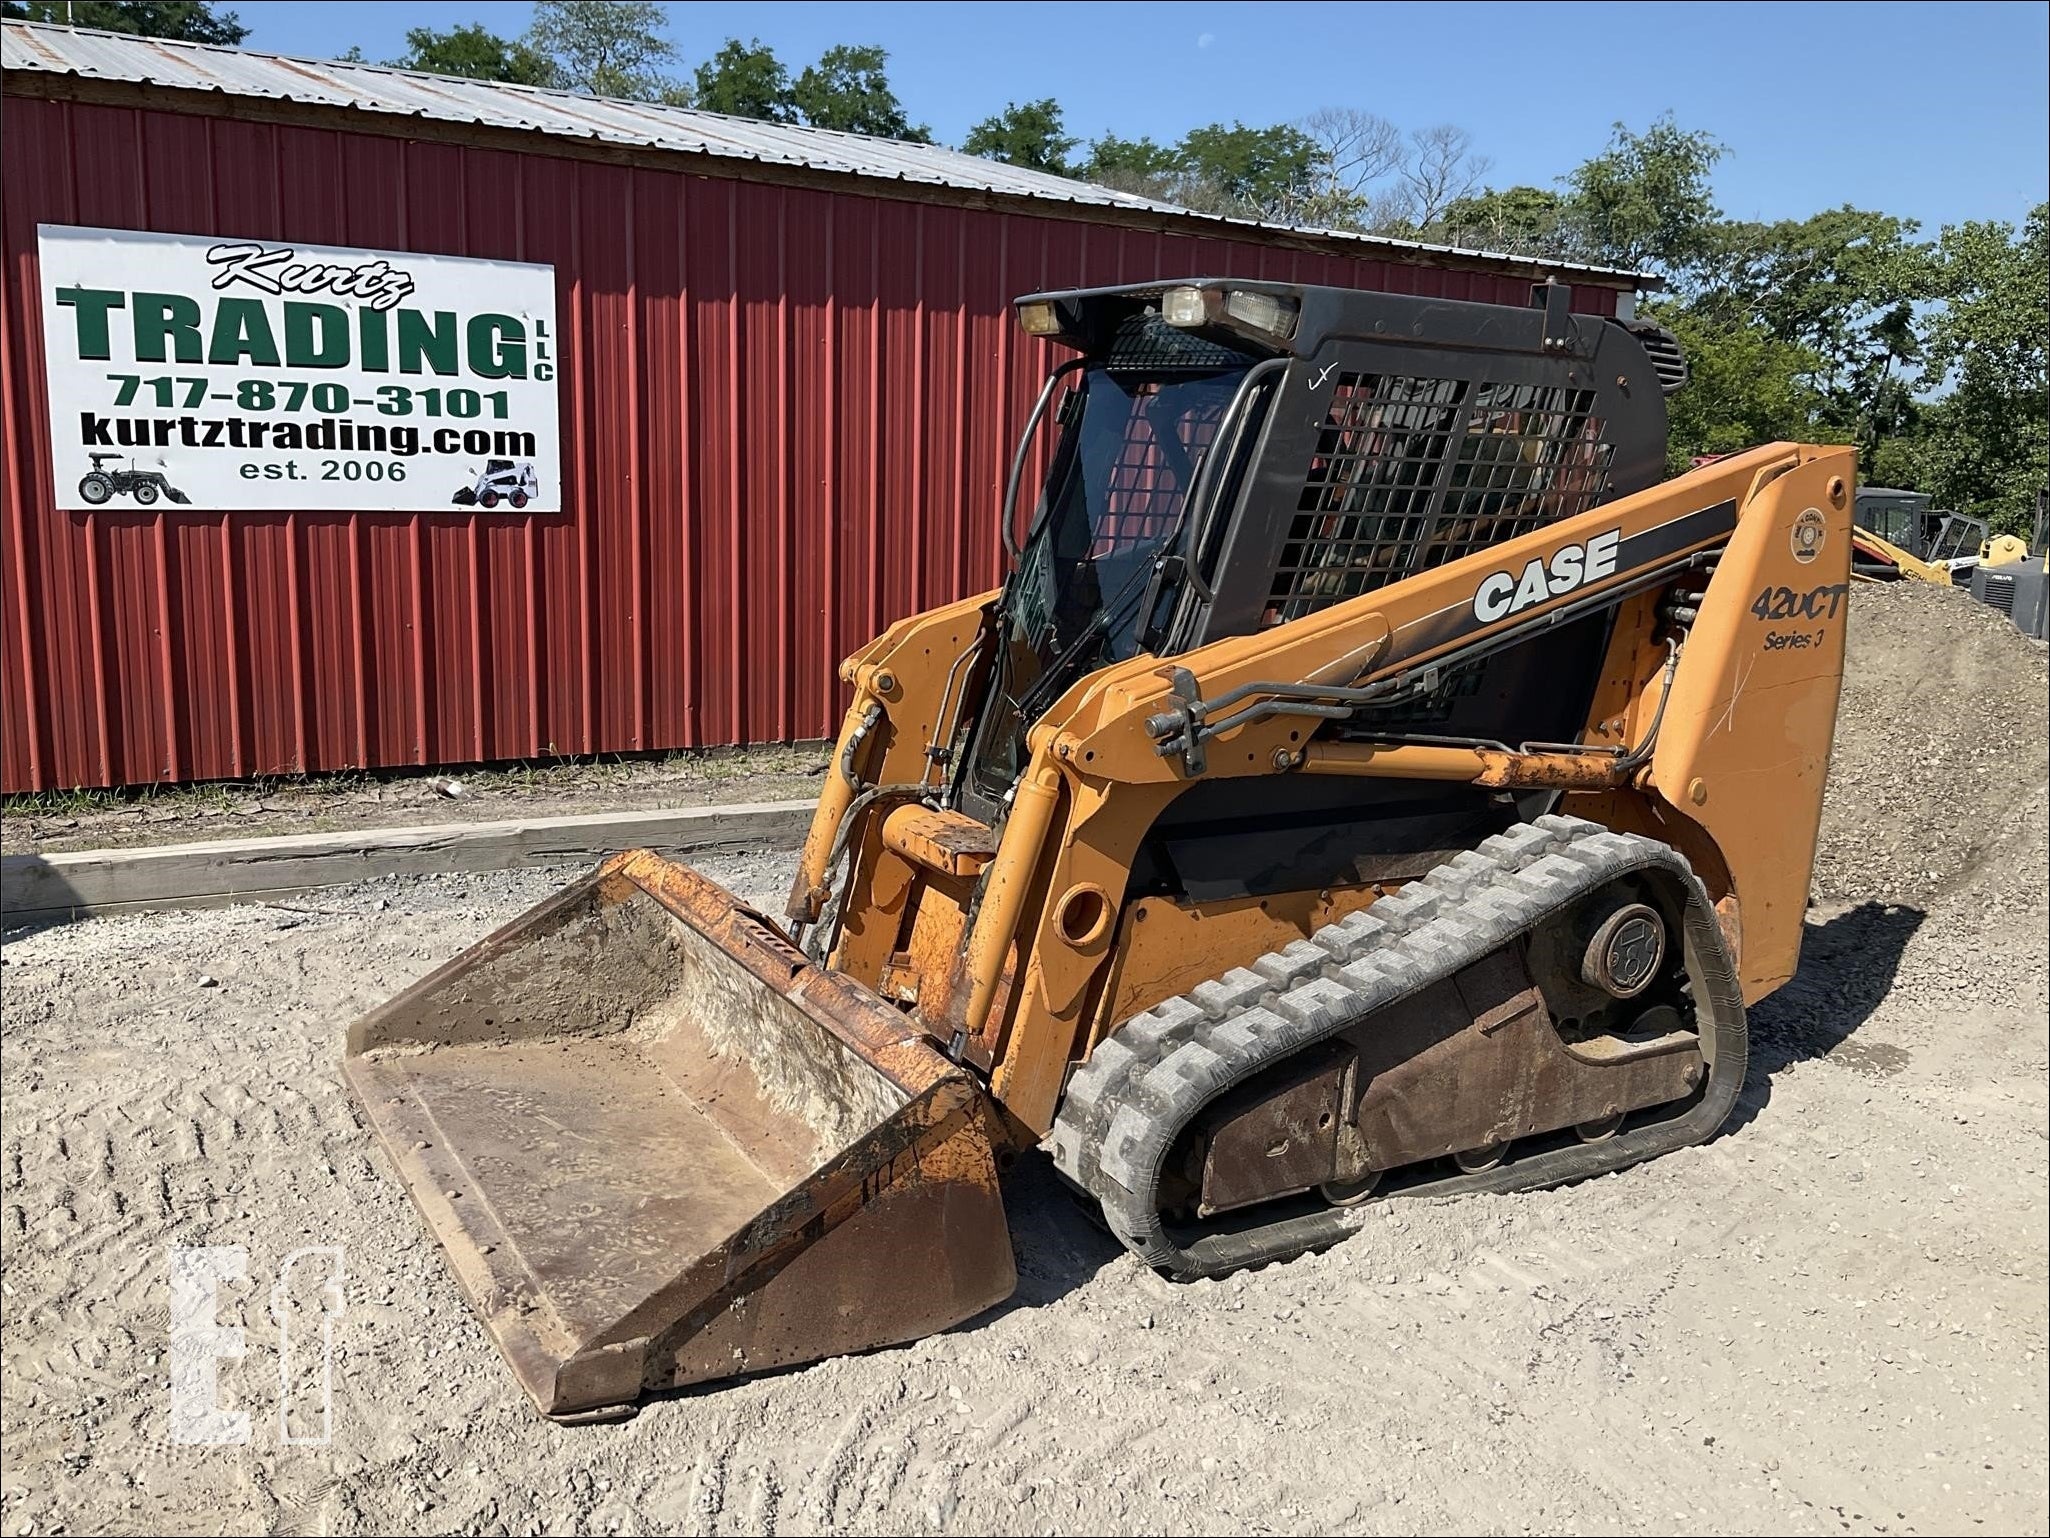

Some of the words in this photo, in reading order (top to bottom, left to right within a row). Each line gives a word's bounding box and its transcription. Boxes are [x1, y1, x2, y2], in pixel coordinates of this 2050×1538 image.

[206, 243, 415, 311] Kurtz
[55, 287, 528, 381] TRADING
[534, 319, 554, 382] LLC
[106, 374, 508, 420] 717-870-3101
[80, 412, 536, 457] kurtztrading.com
[239, 459, 308, 480] est.
[320, 460, 408, 482] 2006
[1473, 527, 1622, 624] CASE
[1763, 630, 1812, 651] Series
